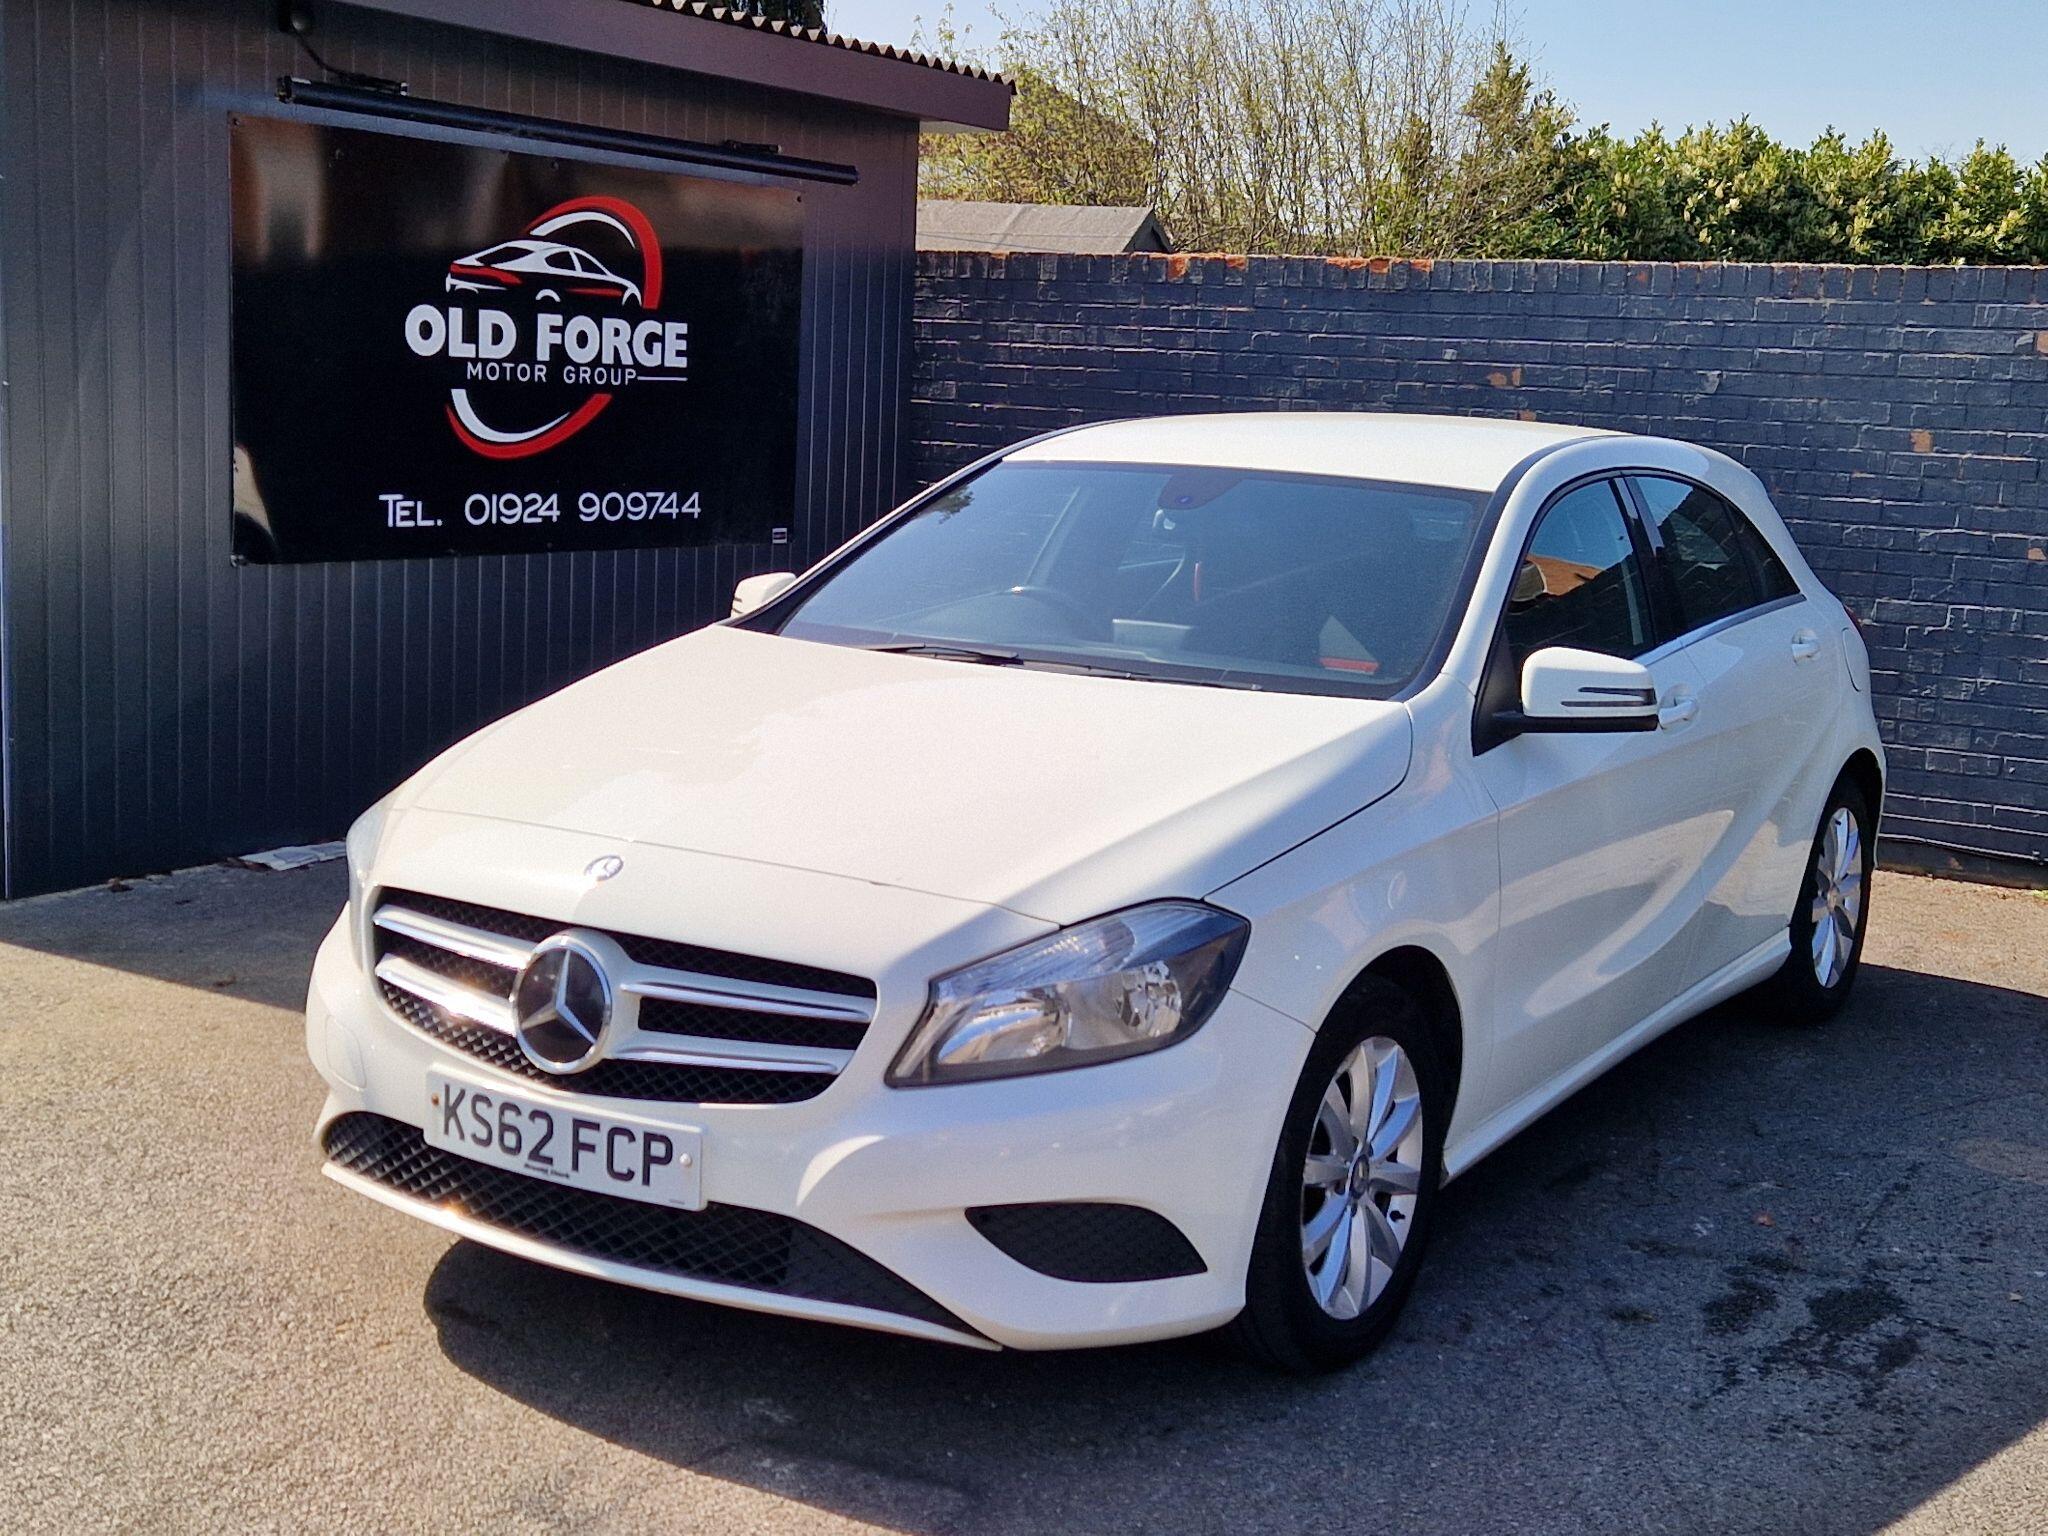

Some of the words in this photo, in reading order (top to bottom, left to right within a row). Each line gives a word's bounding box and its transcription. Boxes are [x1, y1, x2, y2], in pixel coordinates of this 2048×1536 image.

[405, 304, 516, 360] OLD
[536, 314, 688, 368] FORGE
[466, 362, 547, 383] MOTOR
[563, 366, 638, 385] GROUP
[378, 493, 443, 528] TEL.
[465, 493, 561, 526] 01924
[578, 491, 701, 522] 909744
[444, 1084, 555, 1166] KS62
[571, 1118, 675, 1187] FCP
